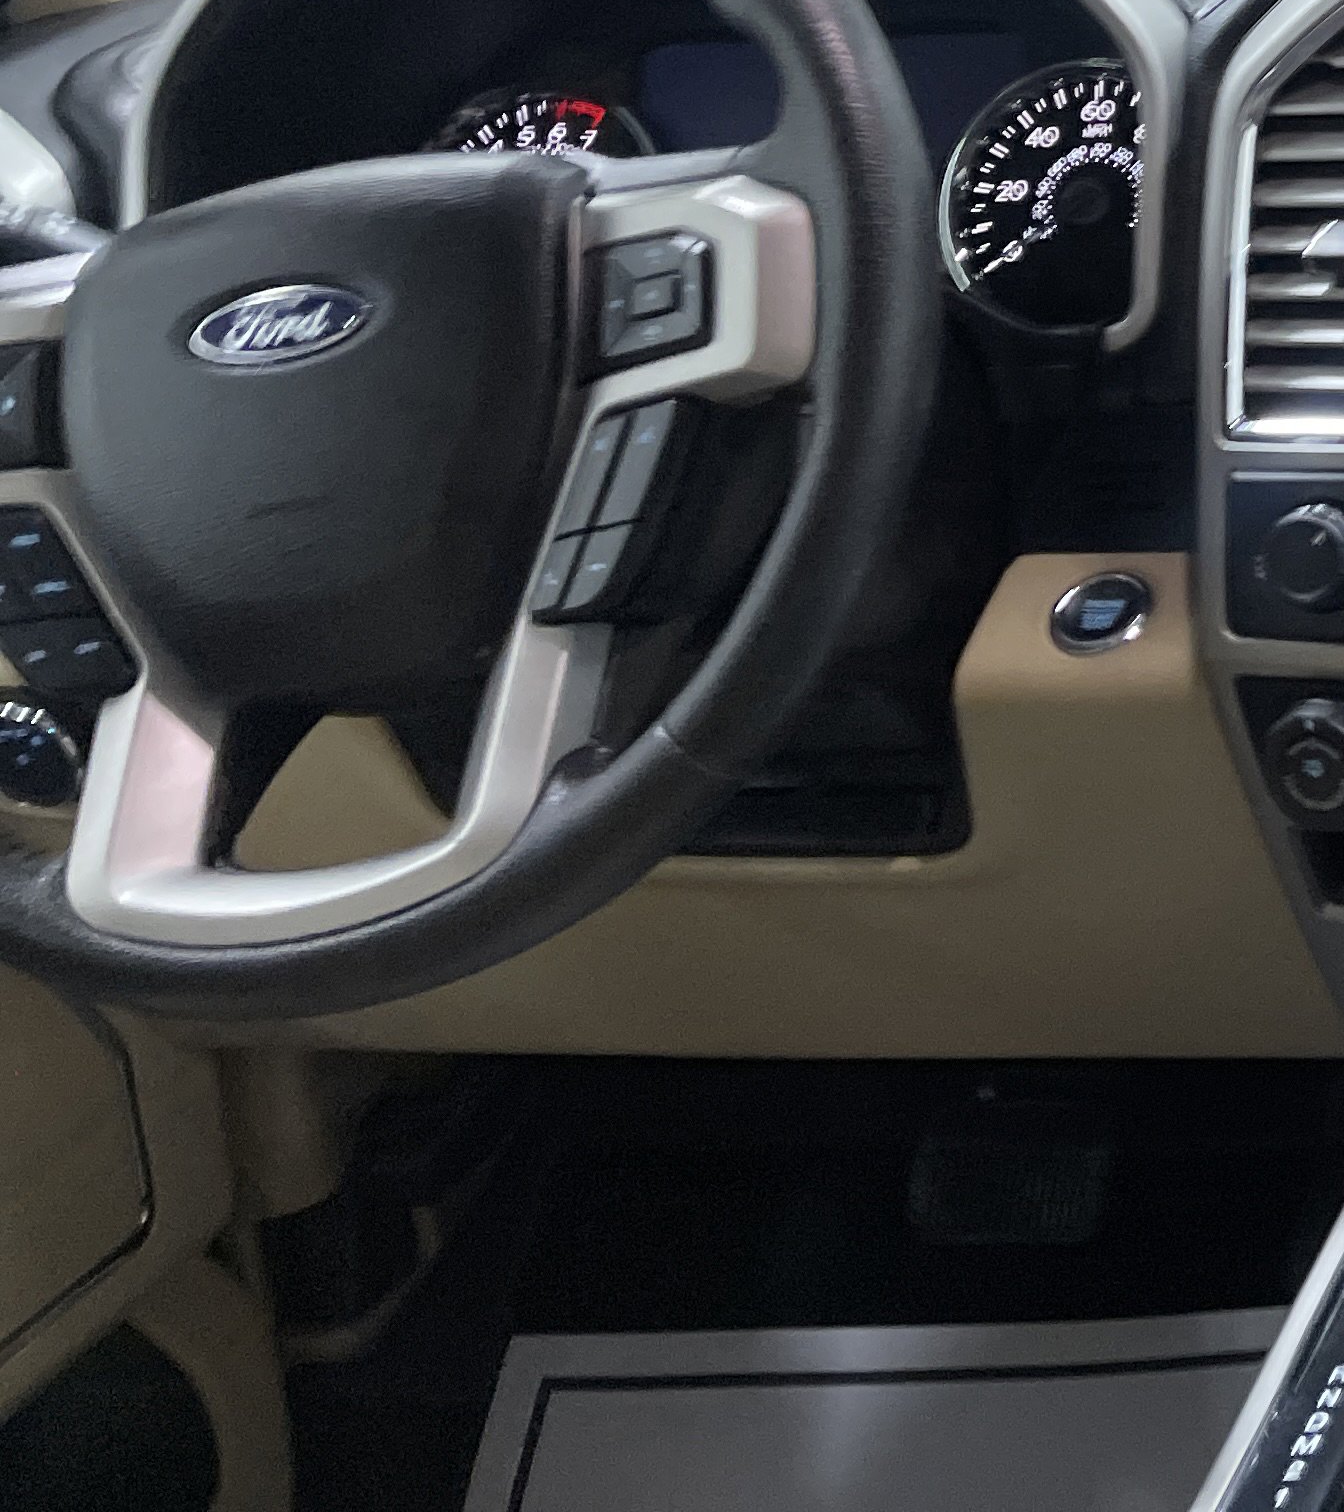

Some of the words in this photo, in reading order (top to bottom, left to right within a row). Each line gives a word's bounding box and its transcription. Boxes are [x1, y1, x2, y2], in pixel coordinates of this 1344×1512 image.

[1080, 99, 1116, 122] 60
[516, 125, 536, 148] 5
[547, 122, 567, 145] 6
[579, 129, 598, 150] 7
[1025, 126, 1060, 148] 40
[995, 179, 1029, 202] 20
[218, 300, 335, 352] Ford
